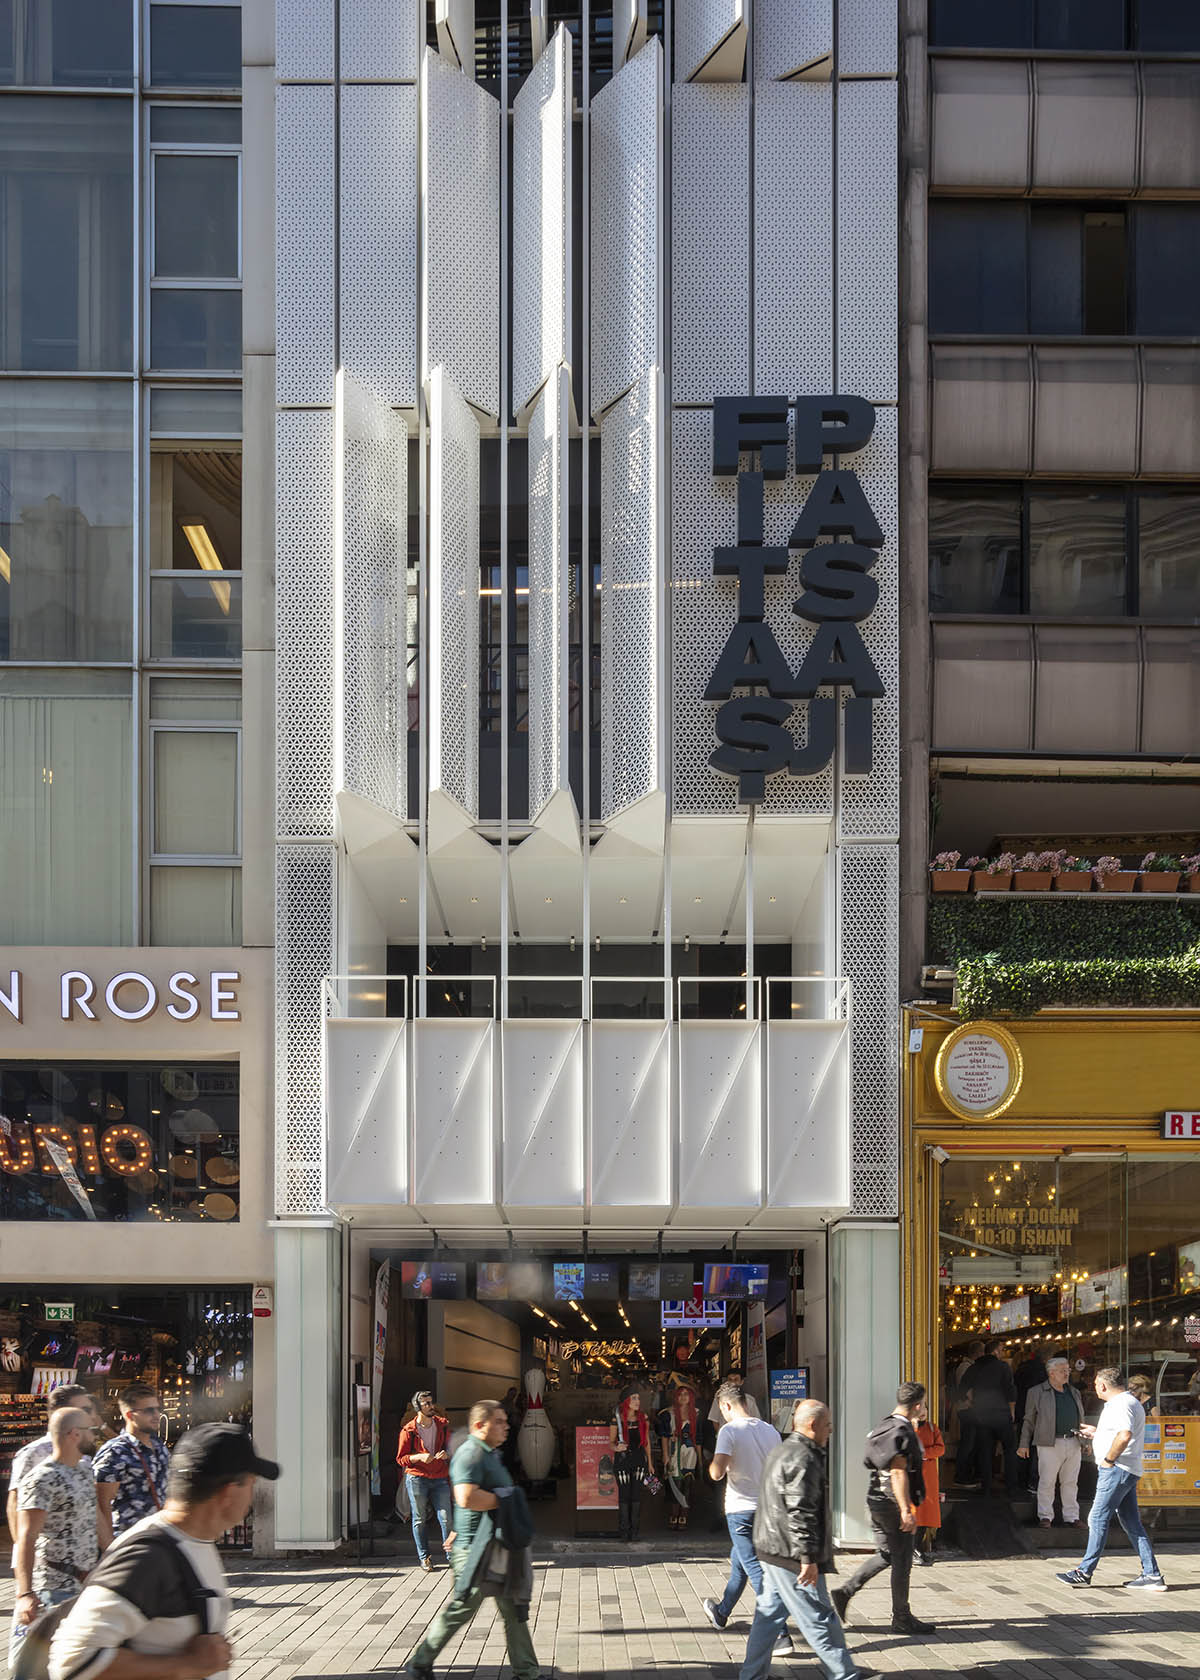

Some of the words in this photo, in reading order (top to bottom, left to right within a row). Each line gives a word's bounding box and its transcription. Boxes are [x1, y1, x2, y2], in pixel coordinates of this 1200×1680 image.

[786, 395, 886, 776] PASAJI
[60, 970, 240, 1020] ROSE
[1170, 1114, 1200, 1135] RE
[964, 1208, 1025, 1224] MEHMET
[975, 1228, 1016, 1245] NO:10
[1021, 1225, 1072, 1248] İŞHANI
